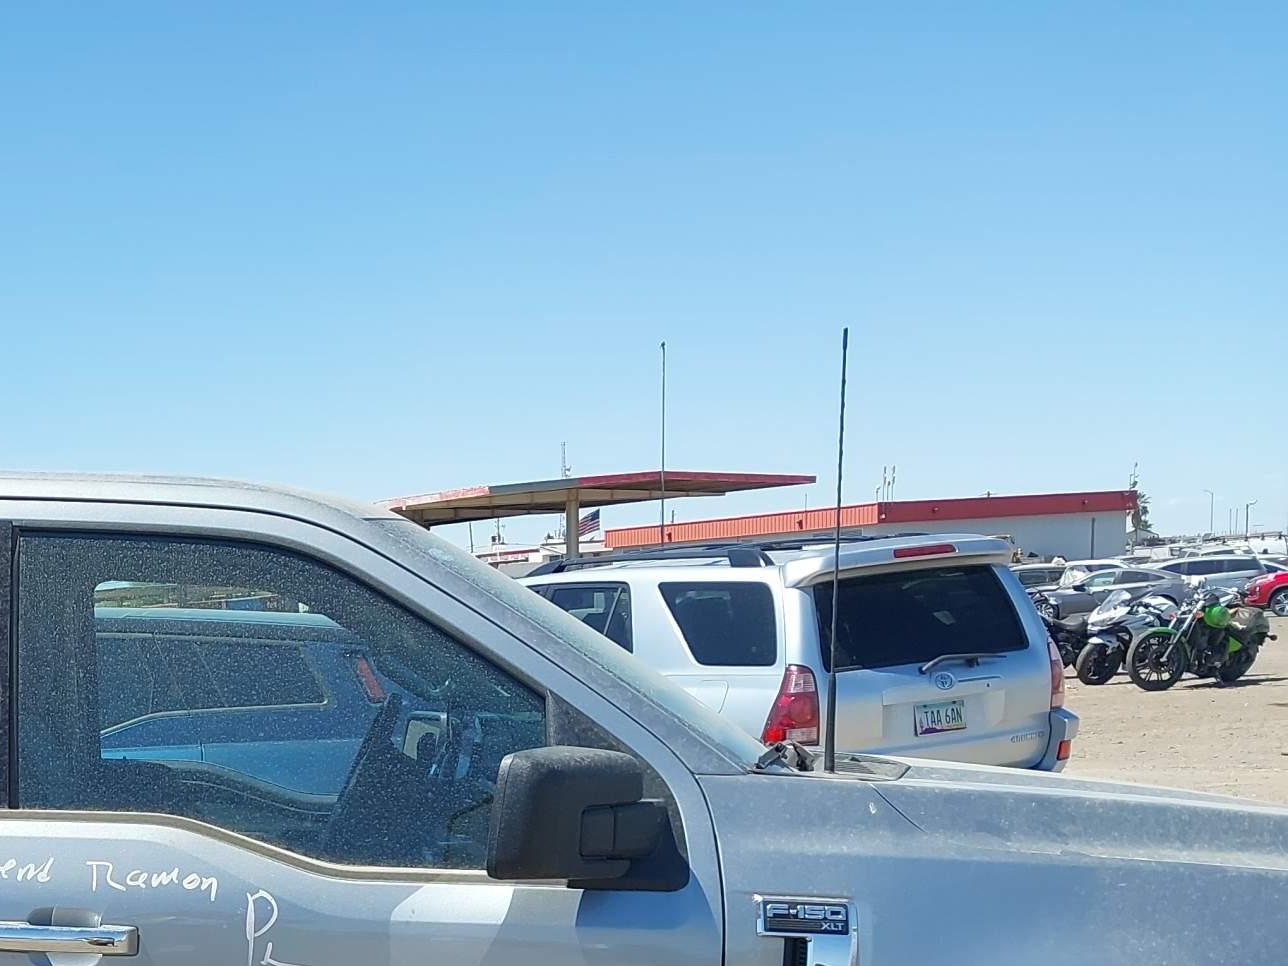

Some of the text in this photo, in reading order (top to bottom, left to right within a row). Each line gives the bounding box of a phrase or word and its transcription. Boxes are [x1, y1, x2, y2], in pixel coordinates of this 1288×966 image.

[86, 860, 218, 902] Ramon
[766, 902, 847, 921] F-150
[820, 922, 845, 931] XLT
